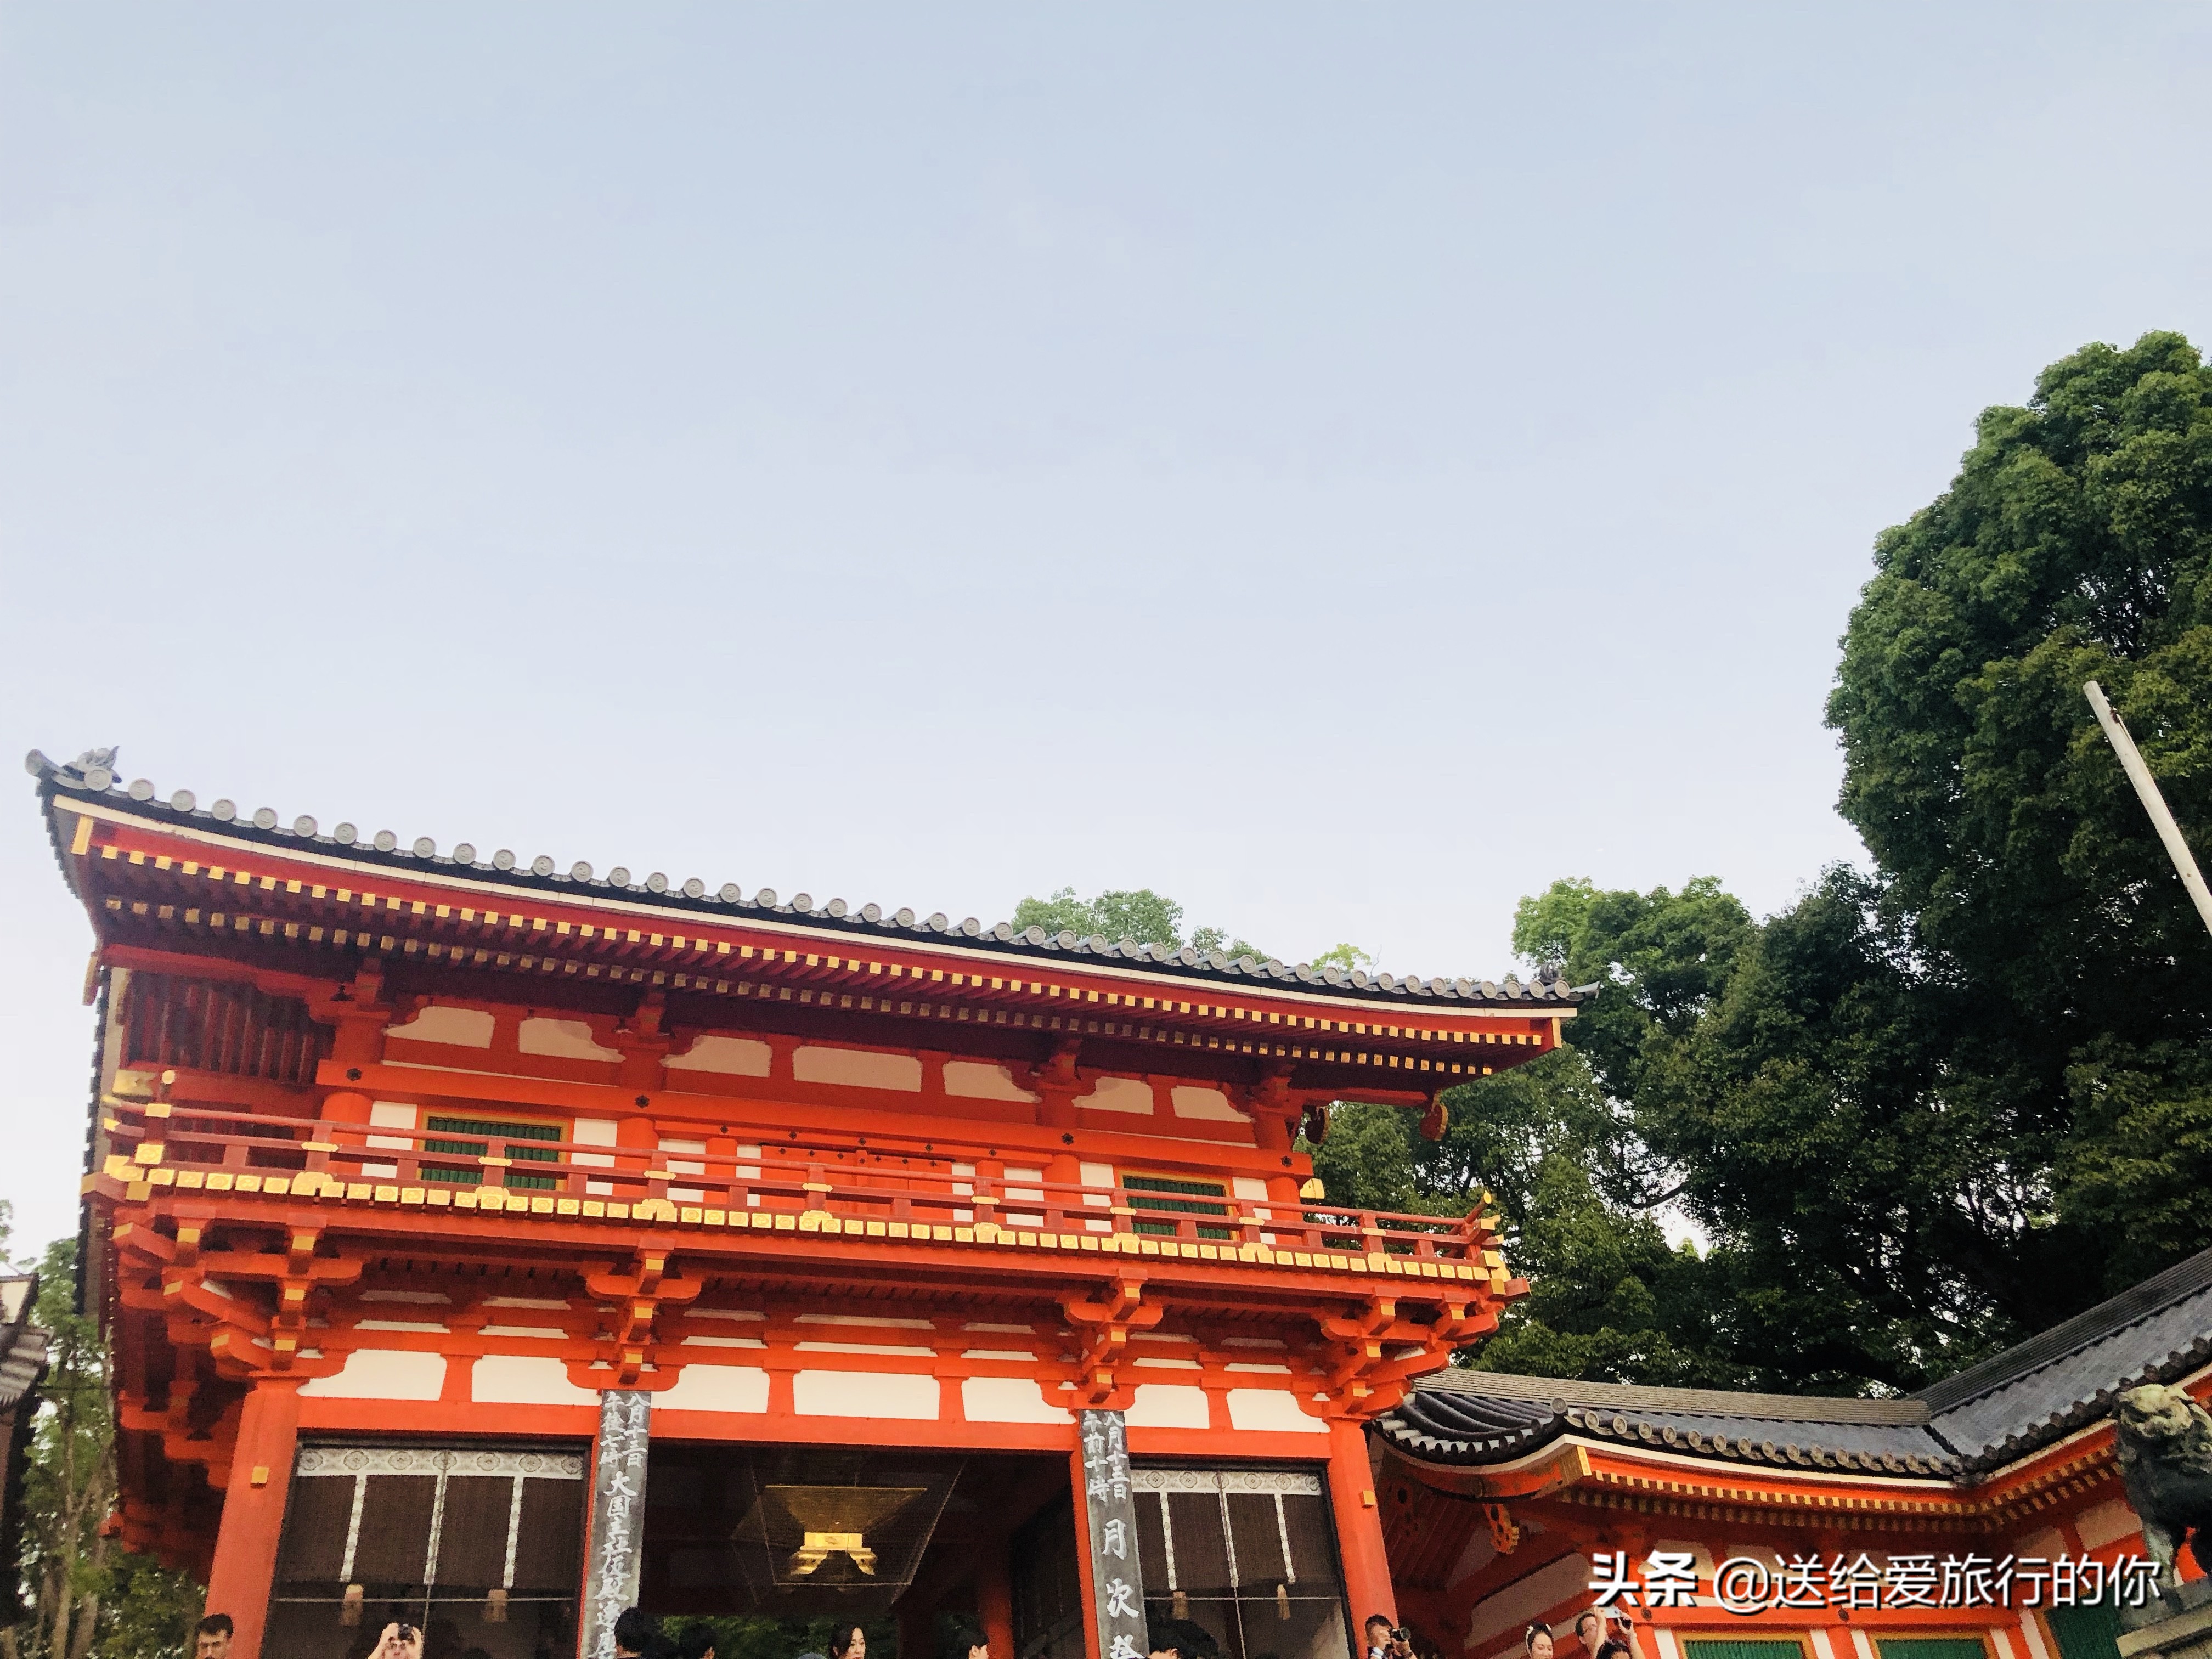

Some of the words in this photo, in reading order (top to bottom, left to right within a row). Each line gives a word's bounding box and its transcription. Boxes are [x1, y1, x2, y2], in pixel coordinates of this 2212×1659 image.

[622, 1392, 650, 1468] 八月十三日
[1083, 1409, 1110, 1502] 午前十時
[588, 1470, 637, 1659] 大国主社仮殿遷座
